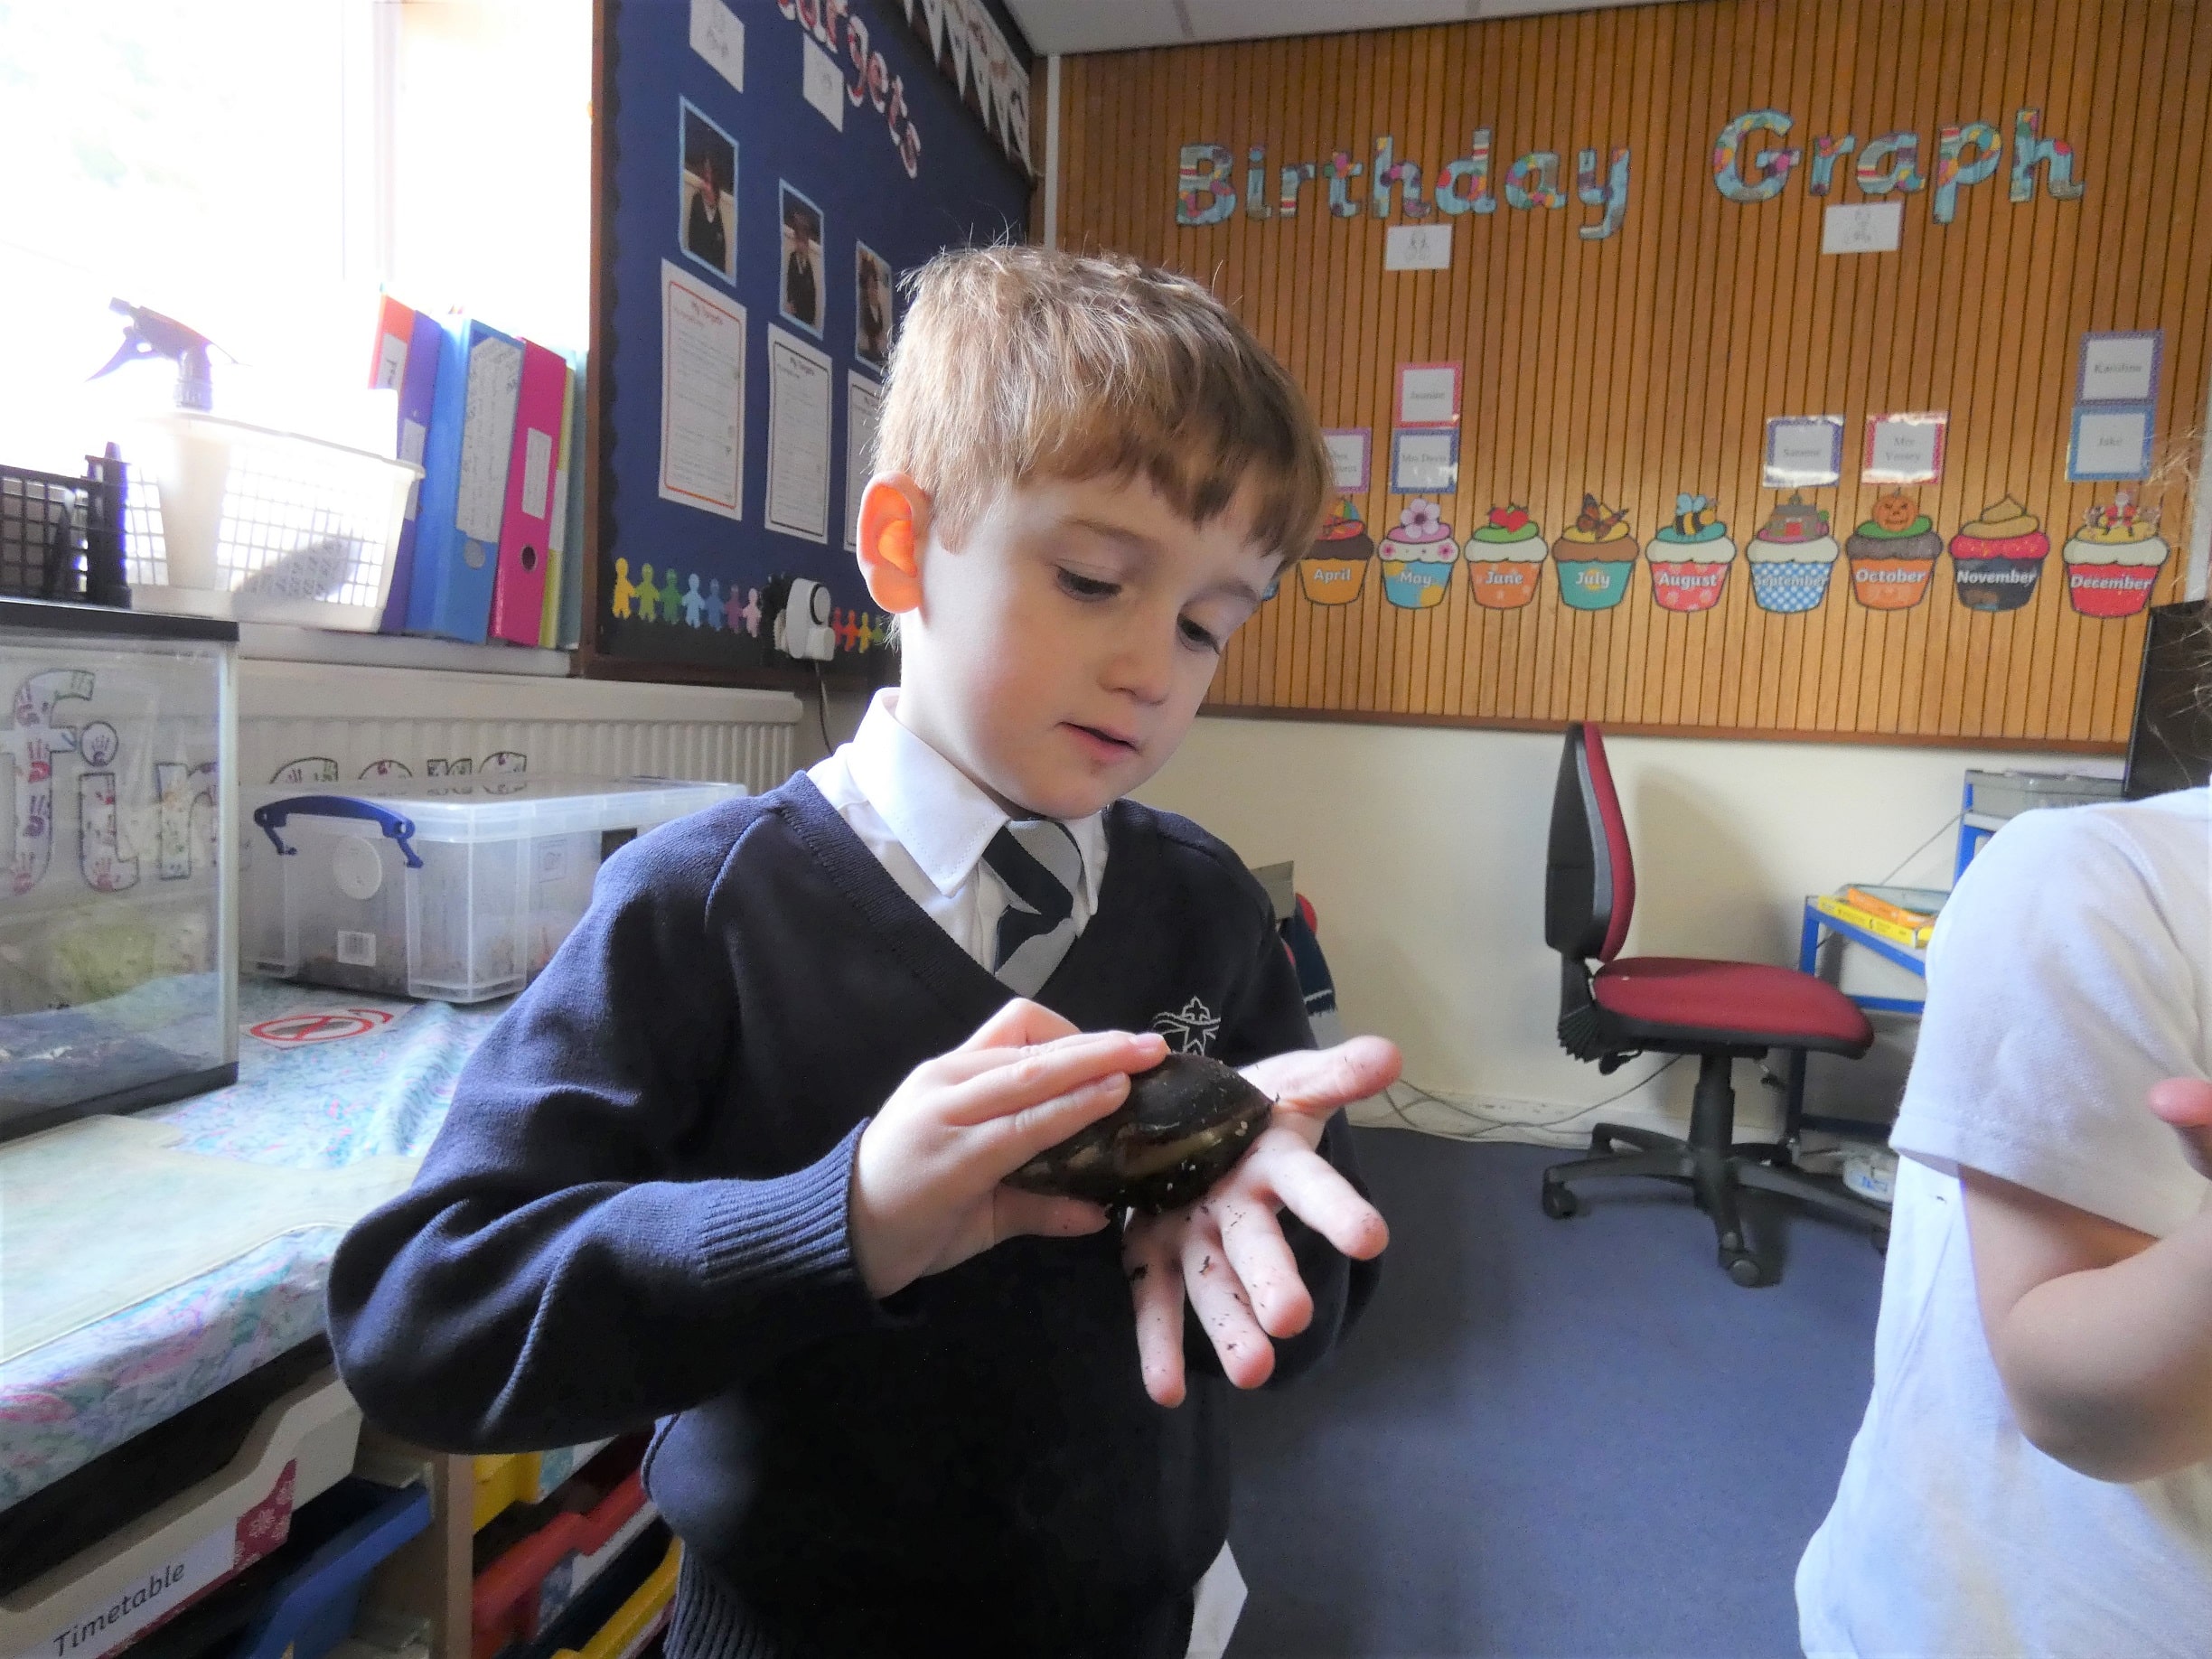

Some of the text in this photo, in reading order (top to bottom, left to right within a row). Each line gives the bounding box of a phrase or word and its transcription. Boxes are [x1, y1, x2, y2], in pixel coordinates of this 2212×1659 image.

[778, 0, 922, 179] argets
[1176, 108, 2085, 240] Birthday Graph
[1313, 567, 1351, 585] April
[1400, 570, 1432, 586] May
[1485, 570, 1524, 585] June
[1575, 571, 1610, 588] July
[1658, 571, 1718, 590] August
[1855, 568, 1926, 585] October
[1956, 569, 2038, 586] November
[2070, 574, 2153, 591] December
[52, 1563, 186, 1657] Timetable
